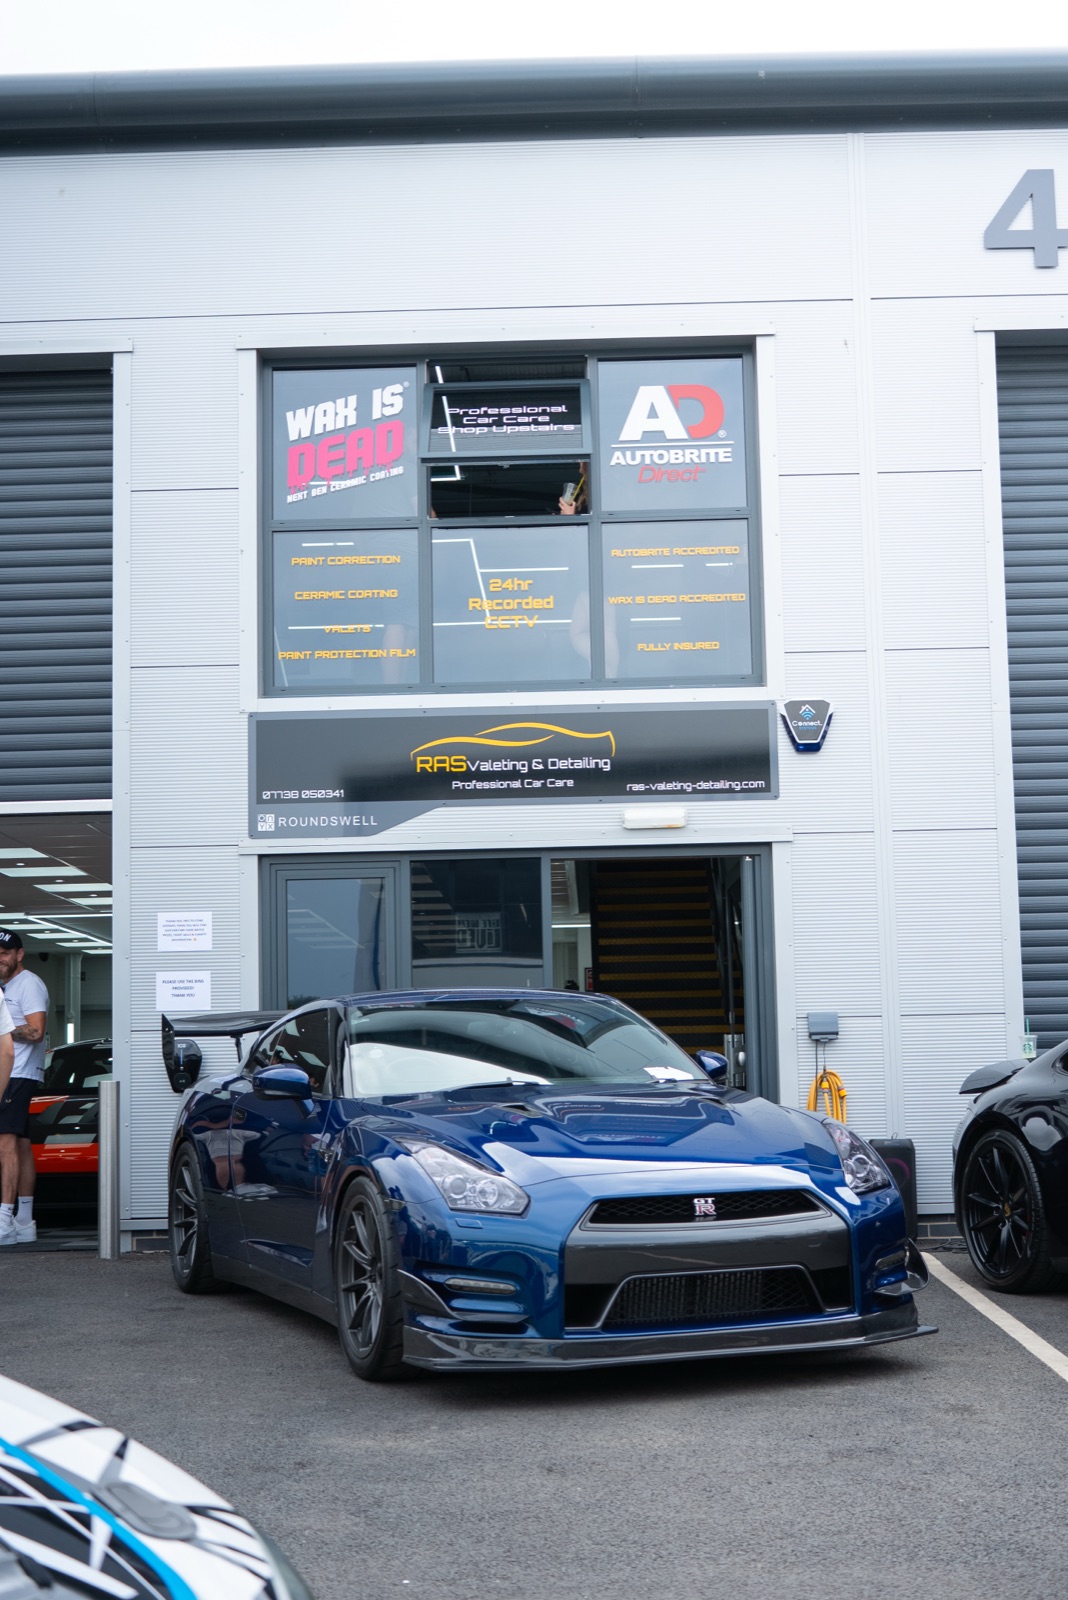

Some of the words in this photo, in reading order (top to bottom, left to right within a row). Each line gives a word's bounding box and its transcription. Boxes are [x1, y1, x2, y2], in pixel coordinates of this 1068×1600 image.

[984, 169, 1068, 268] 4
[286, 394, 357, 441] WAX
[372, 383, 404, 420] IS
[447, 404, 568, 416] Professional
[618, 384, 725, 441] AD
[463, 415, 498, 425] Car
[503, 414, 550, 423] Care
[437, 425, 488, 435] Shop
[492, 422, 575, 433] Upstairs
[287, 419, 404, 492] DEAD
[609, 448, 732, 466] AUTOBRITE
[638, 465, 707, 483] Direct
[287, 490, 308, 503] NEXT
[311, 486, 328, 497] GEN
[330, 477, 367, 492] CERAMIC
[369, 466, 404, 481] COATING
[611, 547, 671, 557] AUTOBRITE
[673, 546, 740, 556] ACCREDITED
[291, 556, 325, 566] PAINT
[327, 555, 401, 566] CORRECTION
[488, 577, 534, 592] 24hr
[294, 590, 345, 600] CERAMIC
[347, 589, 398, 599] COATING
[608, 596, 633, 604] WAX
[635, 595, 645, 604] IS
[647, 595, 677, 604] DEAD
[679, 593, 746, 603] ACCREDITED
[468, 595, 554, 611] Recorded
[484, 614, 539, 629] CCTV
[324, 624, 371, 633] VALETS
[637, 643, 671, 652] FULLY
[674, 641, 720, 651] INSURED
[278, 650, 312, 660] PAINT
[314, 649, 387, 659] PROTECTION
[389, 648, 416, 658] FILM
[416, 755, 467, 773] RAS
[466, 758, 528, 774] Valeting
[532, 758, 544, 770] &
[548, 756, 611, 772] Detailing
[452, 778, 523, 790] Professional
[524, 779, 544, 788] Car
[545, 778, 574, 788] Care
[626, 779, 766, 792] ras-valeting-detailing.com
[262, 790, 299, 800] 07738
[301, 789, 344, 799] 050341
[278, 815, 378, 827] ROUNDSWELL
